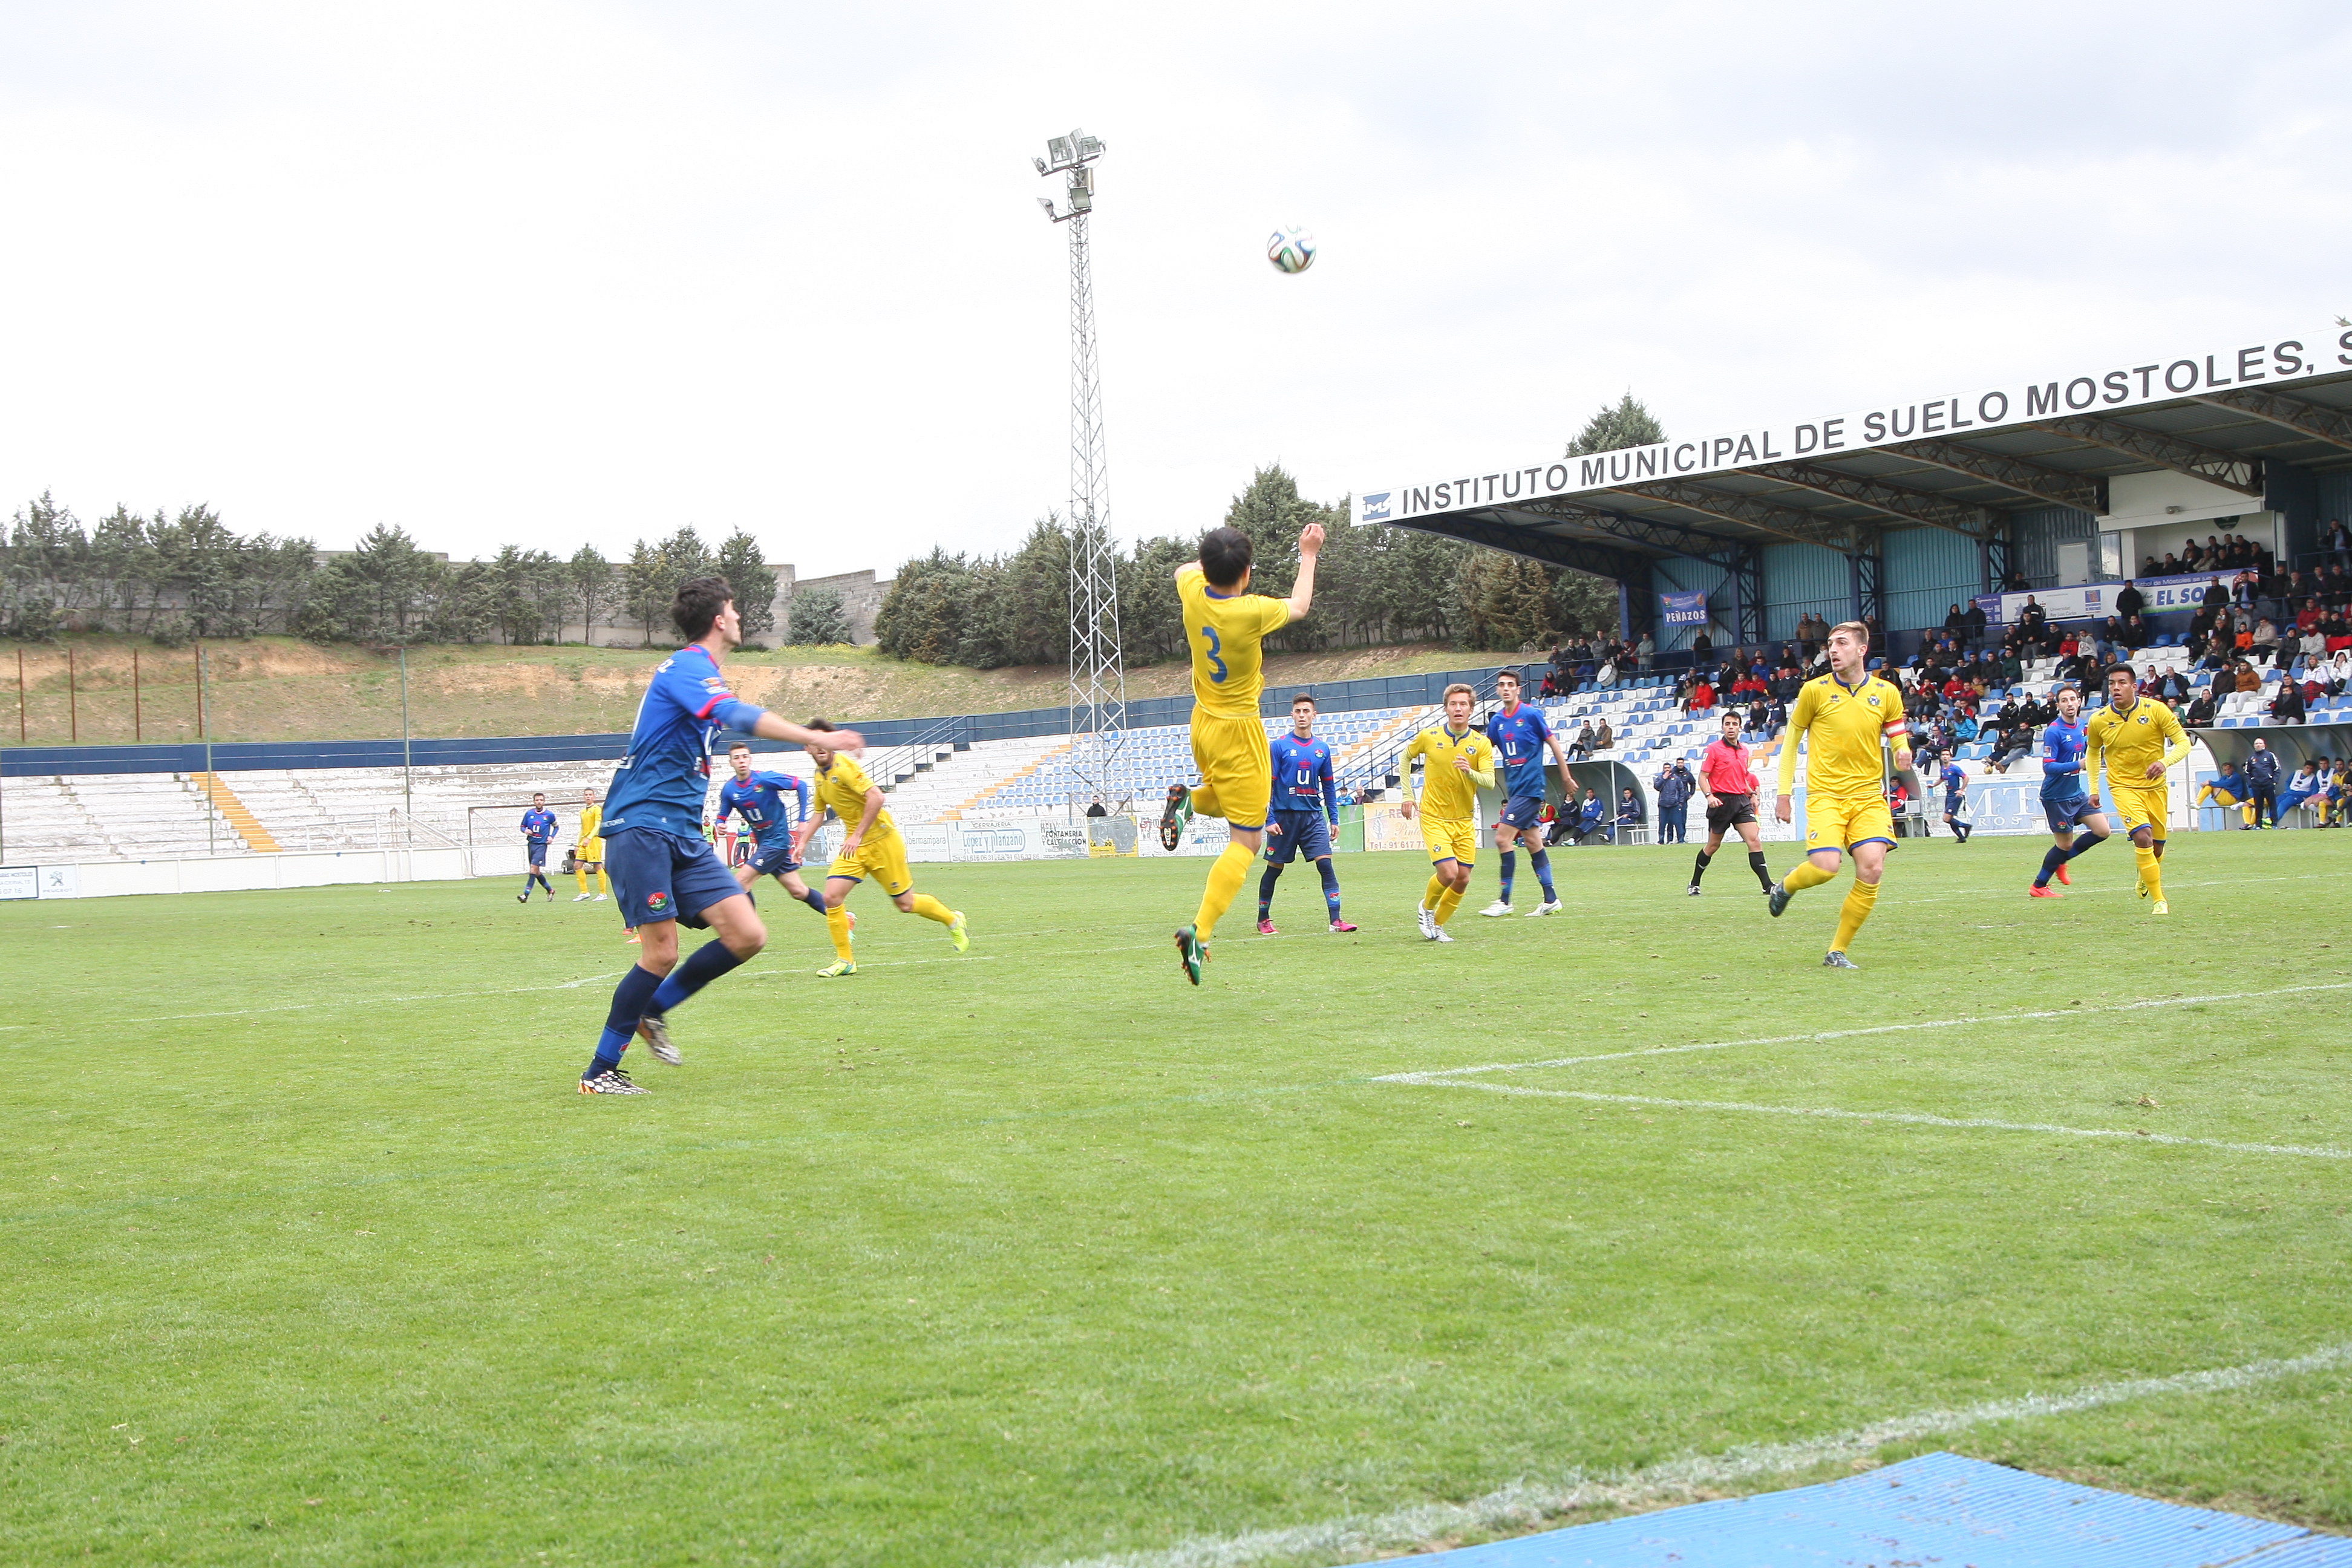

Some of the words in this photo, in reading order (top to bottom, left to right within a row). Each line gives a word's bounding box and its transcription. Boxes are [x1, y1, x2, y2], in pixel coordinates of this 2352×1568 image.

[1403, 464, 1568, 514] INSTITUTO
[1581, 430, 1782, 486] MUNICIPAL
[1795, 418, 1844, 454] DE
[1864, 391, 2008, 443] SUELO
[2027, 341, 2314, 417] MOSTOLES,
[2155, 589, 2175, 606] EL
[1666, 610, 1705, 622] PEÑAZOS
[1202, 626, 1227, 684] 3
[1198, 844, 1226, 856] JAGU
